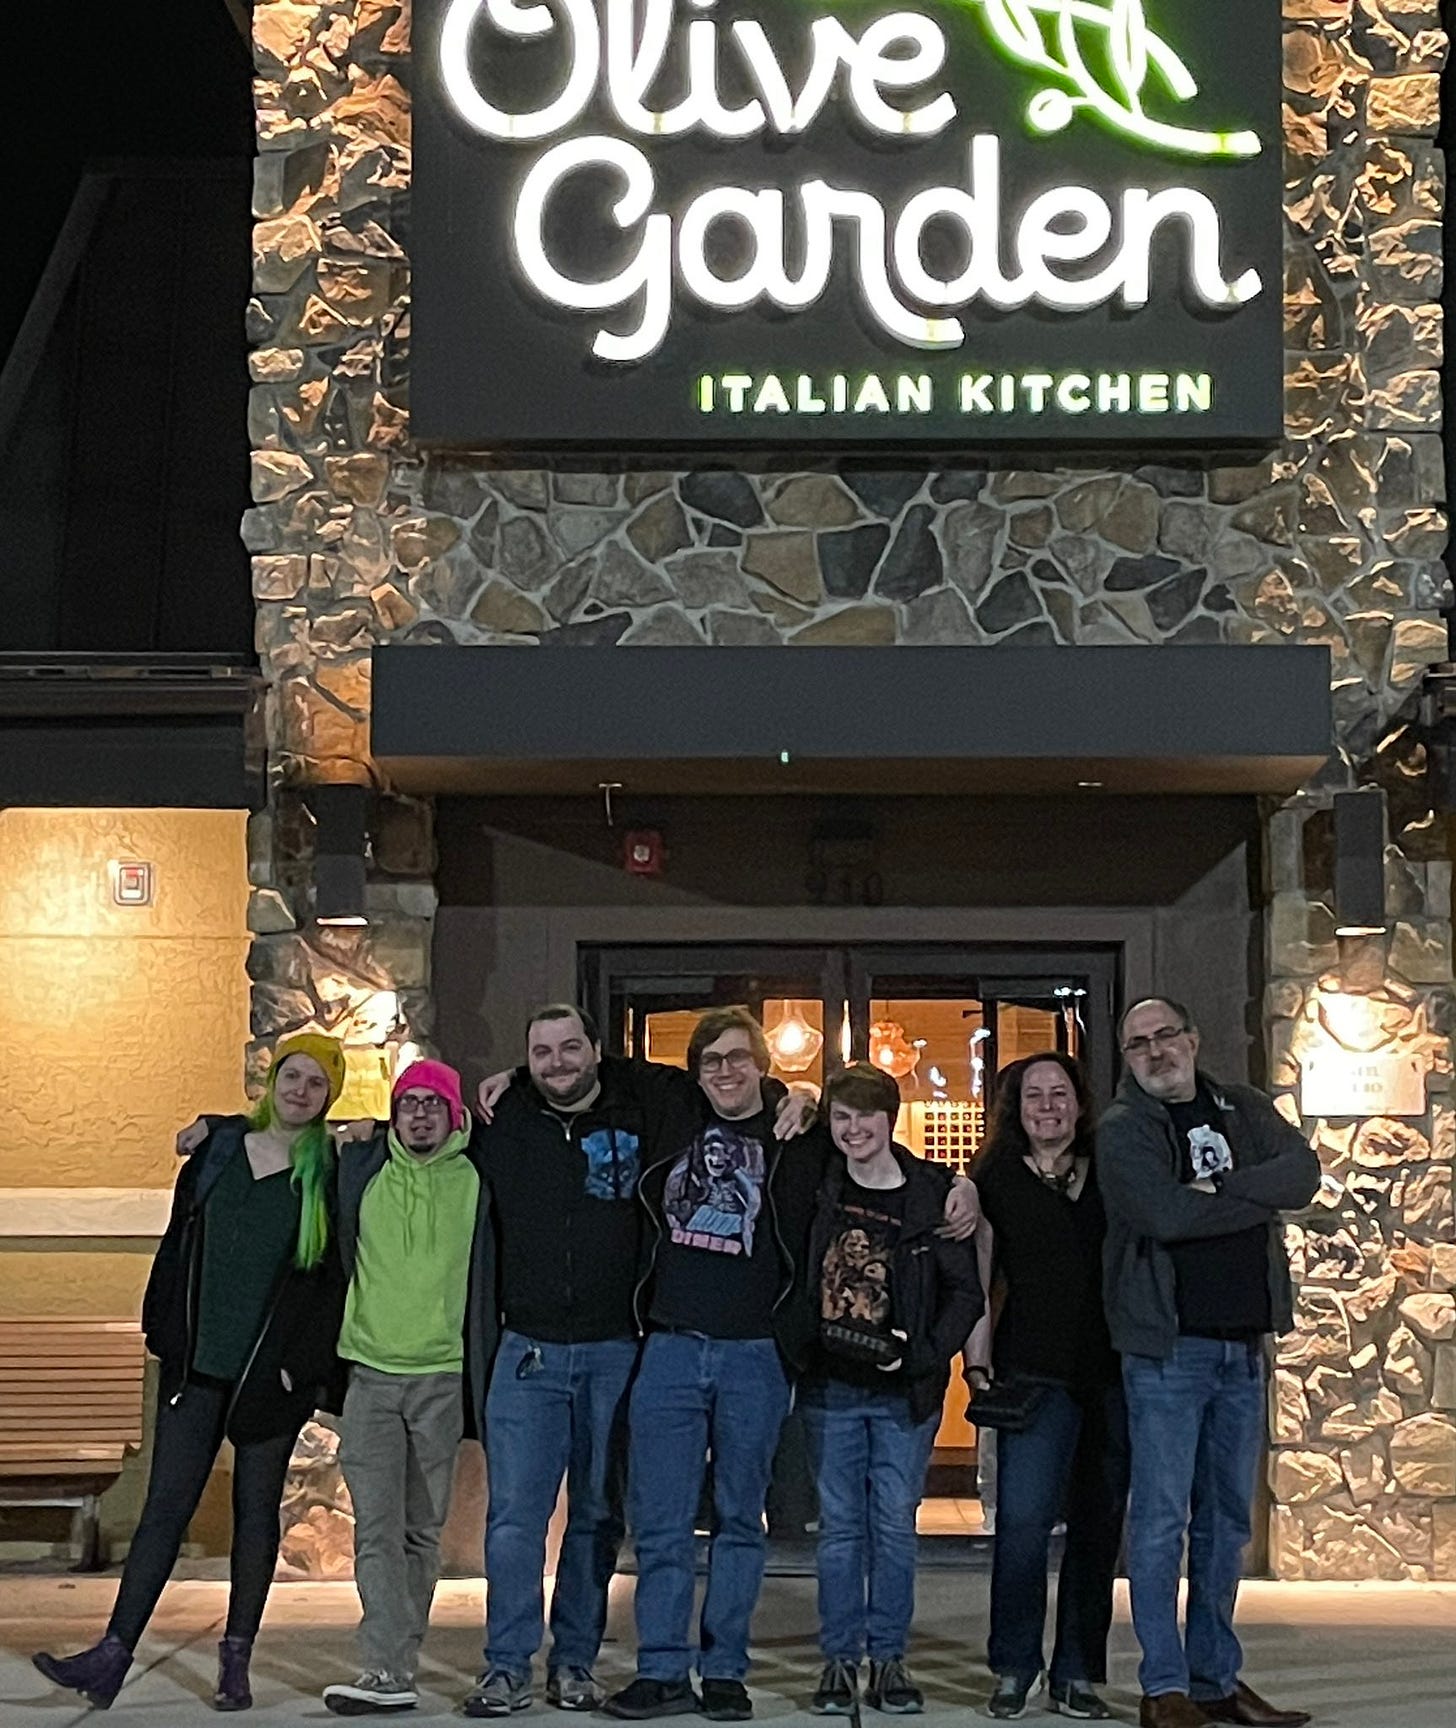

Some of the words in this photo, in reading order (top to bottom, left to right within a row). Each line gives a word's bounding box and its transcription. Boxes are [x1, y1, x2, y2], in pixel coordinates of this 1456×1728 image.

[438, 0, 957, 139] Olive
[513, 134, 1262, 362] Garden
[698, 374, 933, 413] ITALIAN
[960, 374, 1212, 413] KITCHEN
